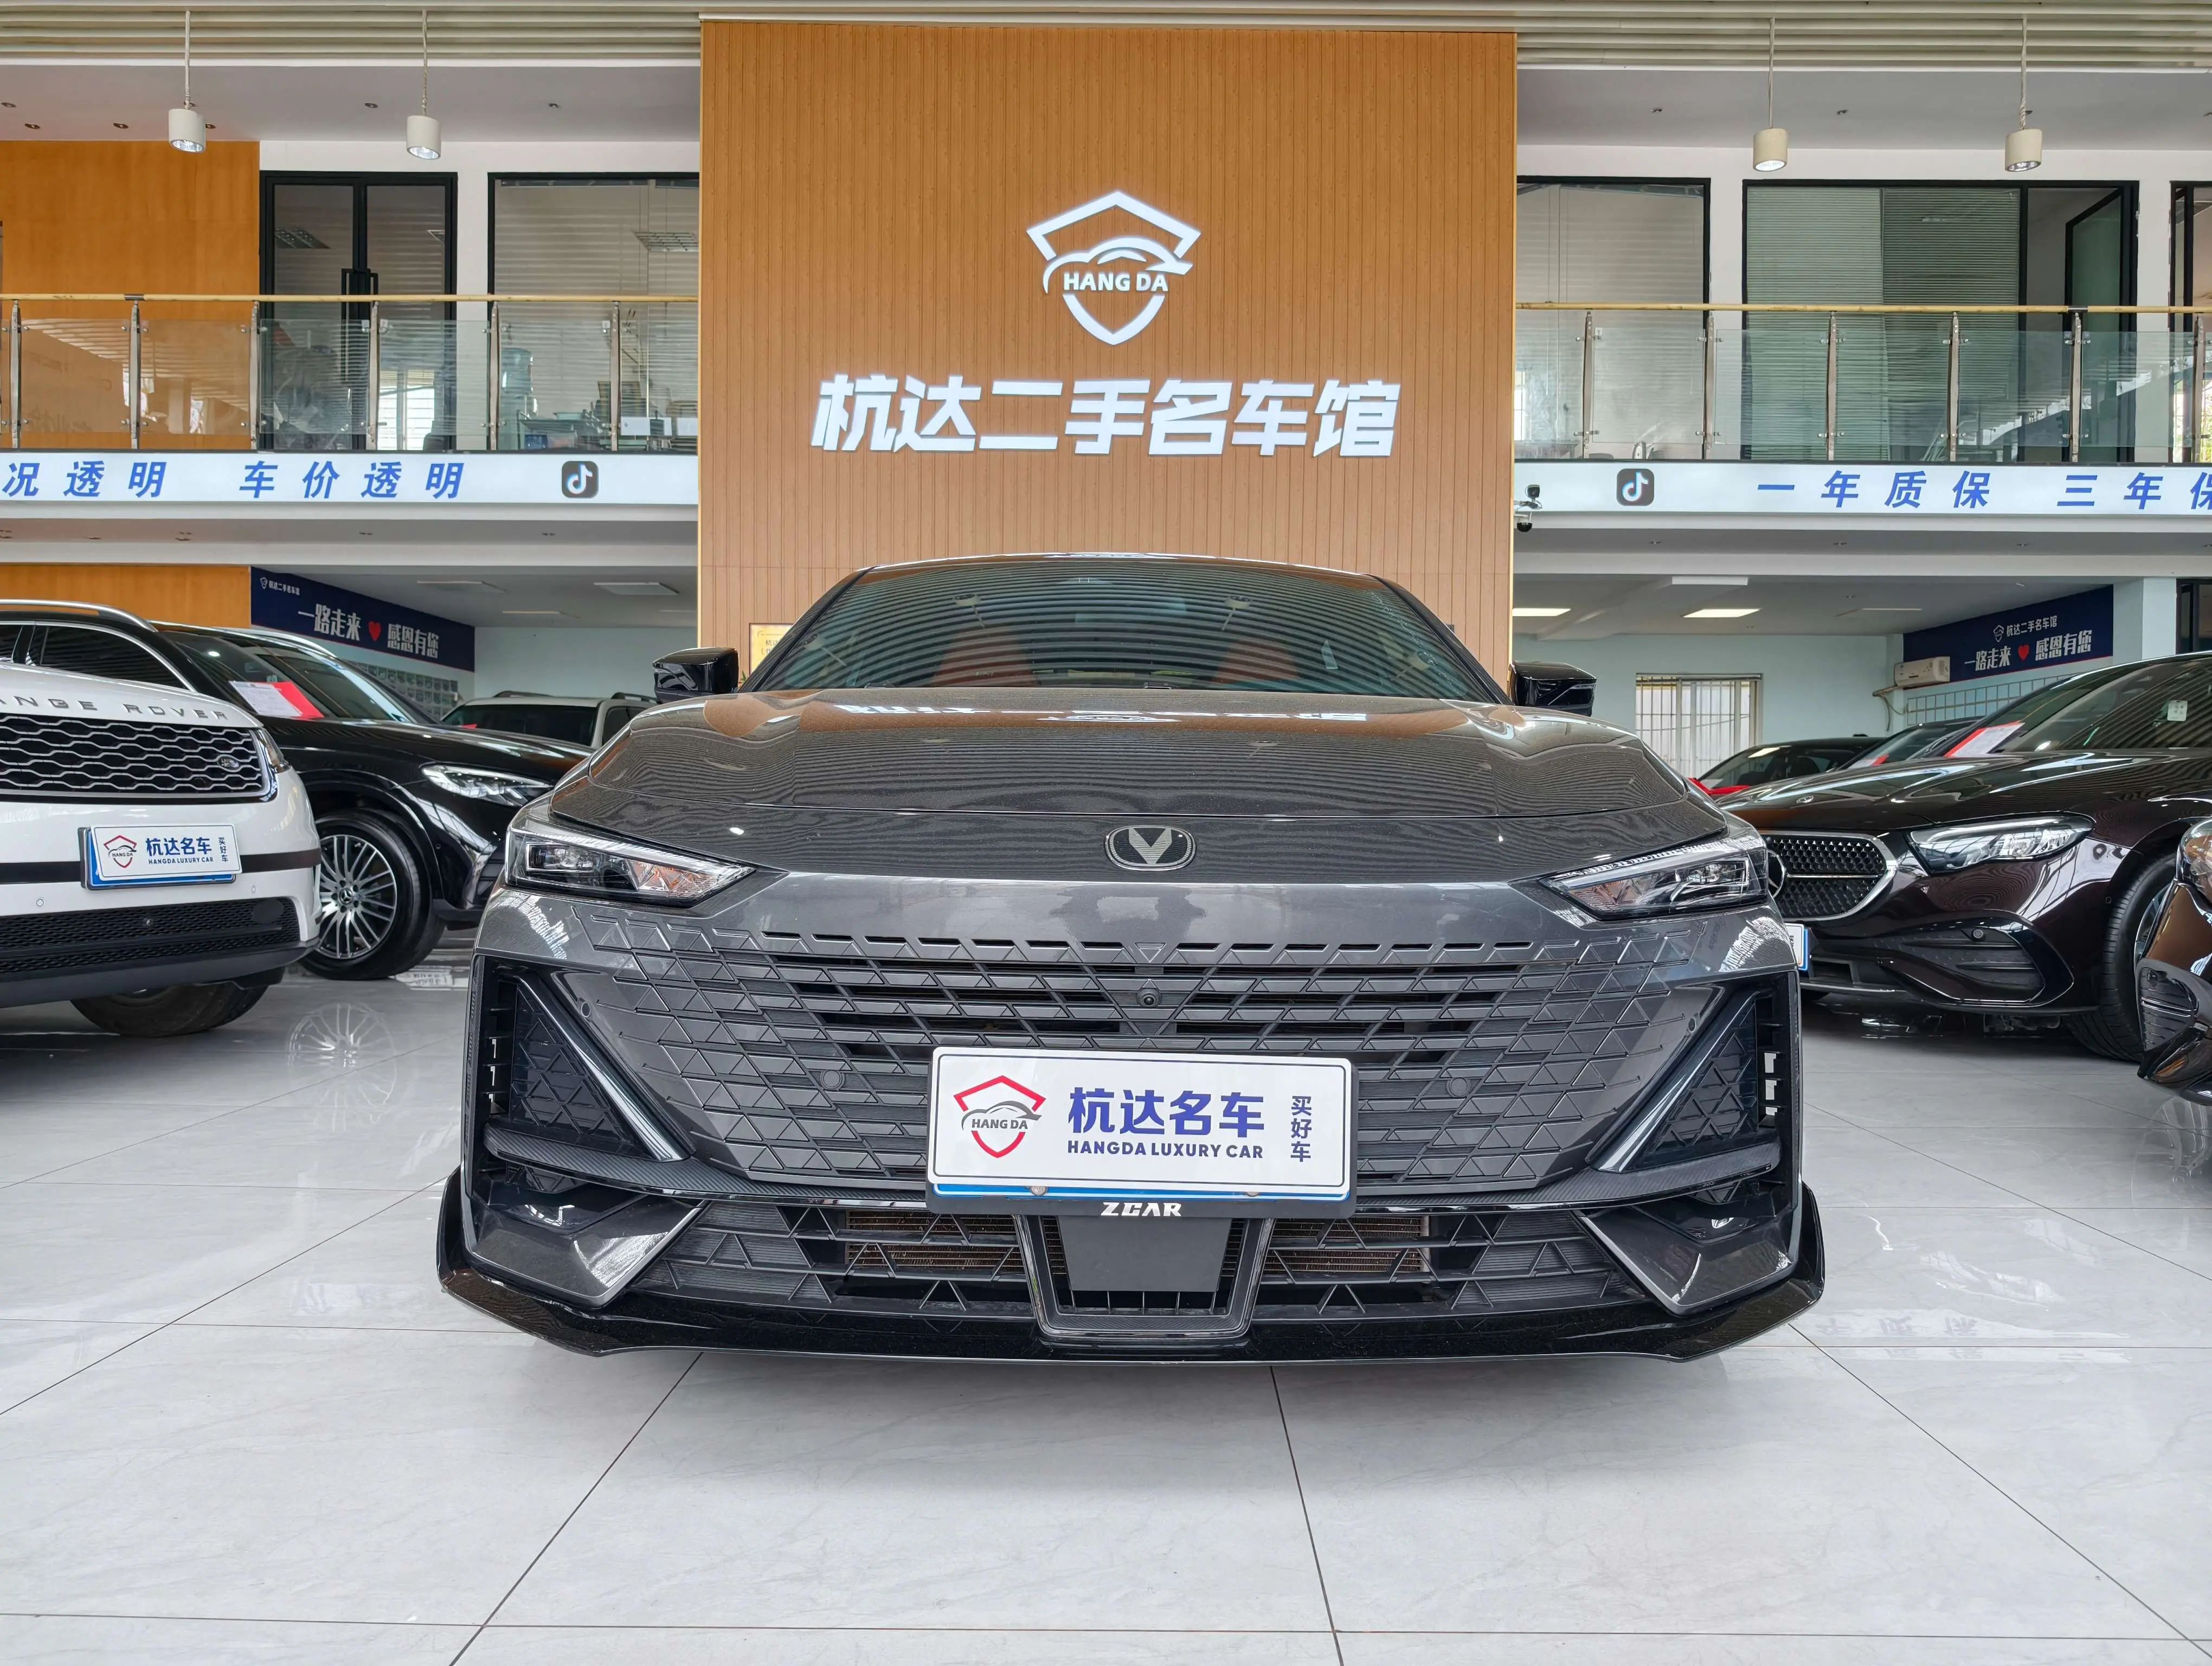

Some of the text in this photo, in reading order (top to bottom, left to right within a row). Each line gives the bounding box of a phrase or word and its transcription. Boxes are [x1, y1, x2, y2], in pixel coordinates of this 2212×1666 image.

[1063, 272, 1168, 292] HANG DA
[811, 374, 1401, 457] 杭达二手名车馆
[2, 460, 465, 499] 况透明 车价透明
[1758, 470, 1991, 509] 一年质保
[298, 603, 439, 658] 一路走来 感恩有您
[2007, 615, 2057, 637] 杭达二手名车馆
[1964, 629, 2092, 671] 一路走来 感恩有您
[122, 703, 228, 720] ROVER
[146, 837, 212, 857] 杭达名车
[218, 837, 229, 862] 买好车
[972, 1118, 1028, 1131] HANG DA
[1068, 1087, 1265, 1138] 杭达名车
[1290, 1095, 1312, 1162] 买好车
[1068, 1140, 1264, 1159] HANGDA LUXURY CAR
